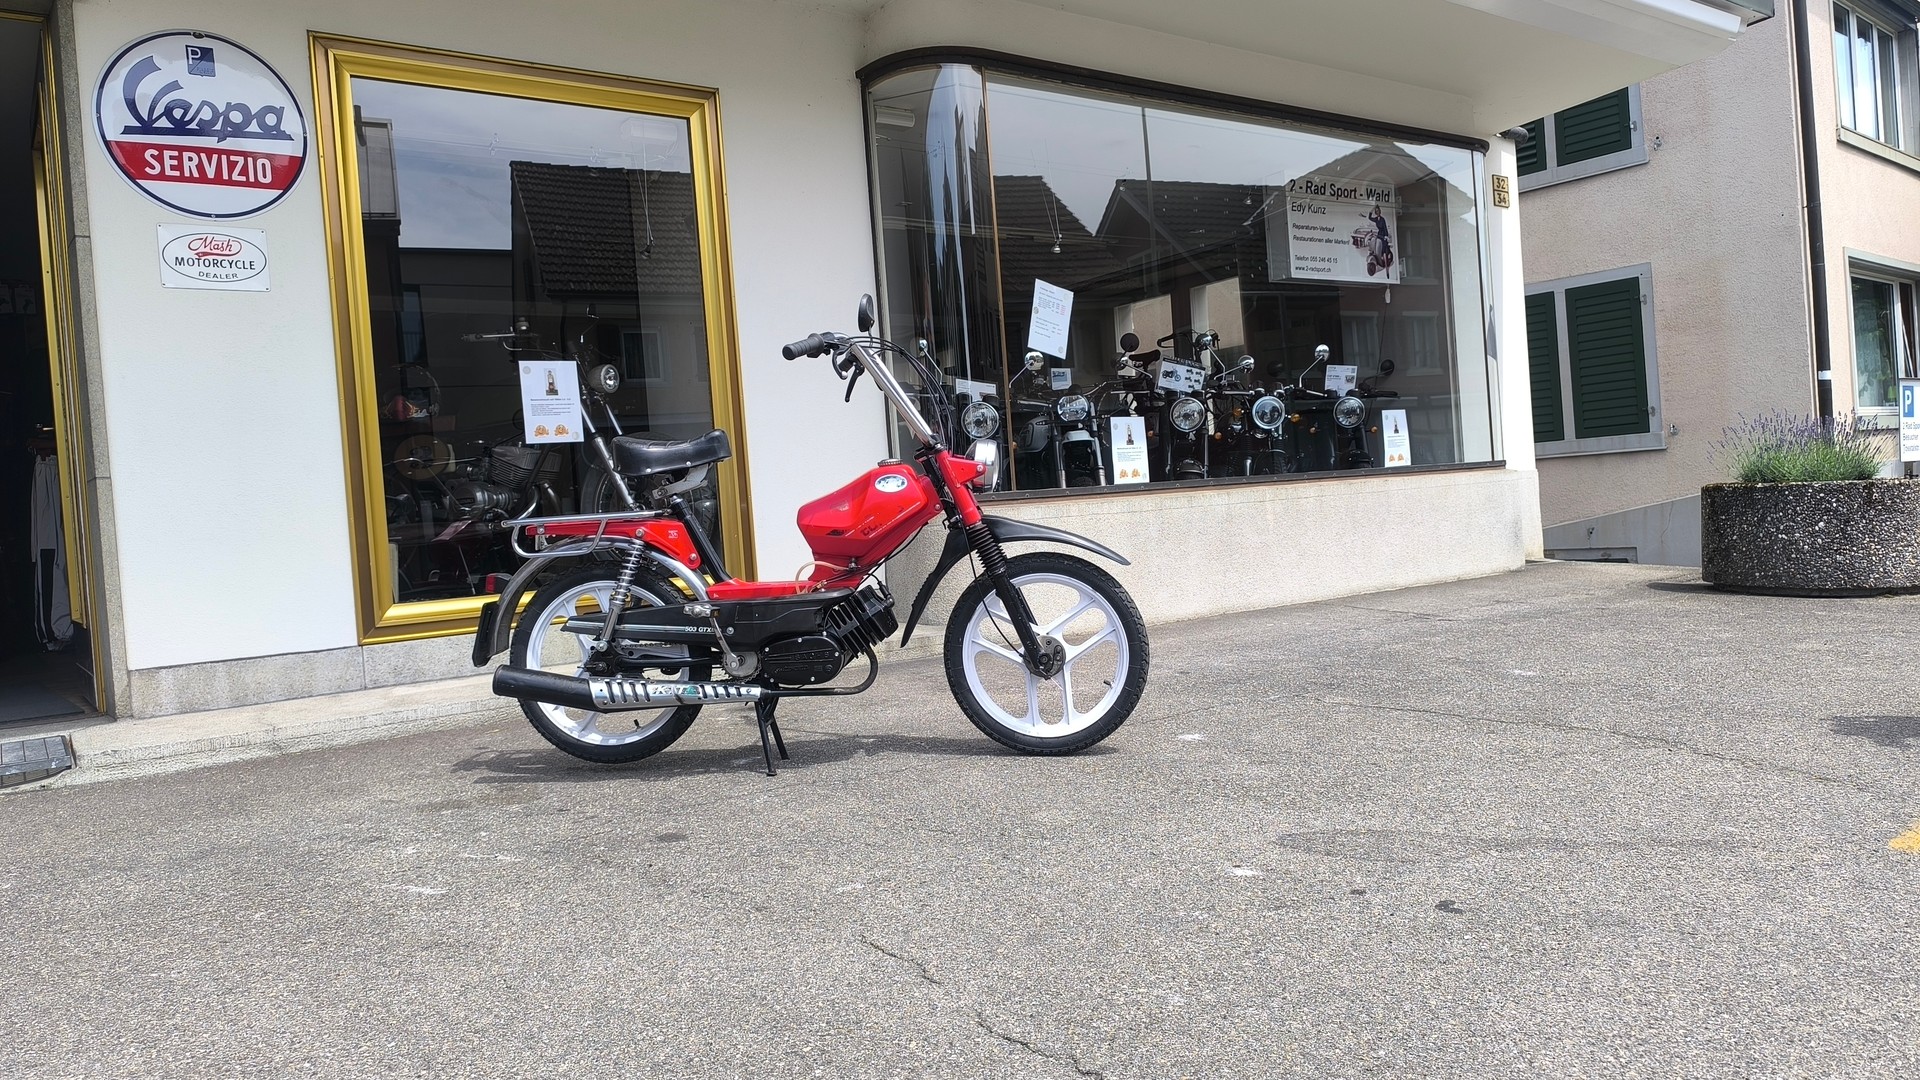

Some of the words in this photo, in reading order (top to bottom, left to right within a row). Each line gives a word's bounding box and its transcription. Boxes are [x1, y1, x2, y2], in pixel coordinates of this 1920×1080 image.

[187, 47, 201, 65] P
[120, 55, 295, 144] Vespa
[144, 148, 273, 184] SERVIZIO
[1305, 180, 1327, 196] Rad
[1329, 183, 1358, 200] Sport
[1366, 188, 1390, 203] Wald
[1496, 177, 1506, 190] 32
[1291, 201, 1306, 215] Edy
[1307, 203, 1327, 215] Kunz
[187, 235, 242, 257] Mash
[174, 256, 256, 271] MOTORCYCLE
[198, 271, 240, 280] DEALER
[1904, 390, 1912, 414] P
